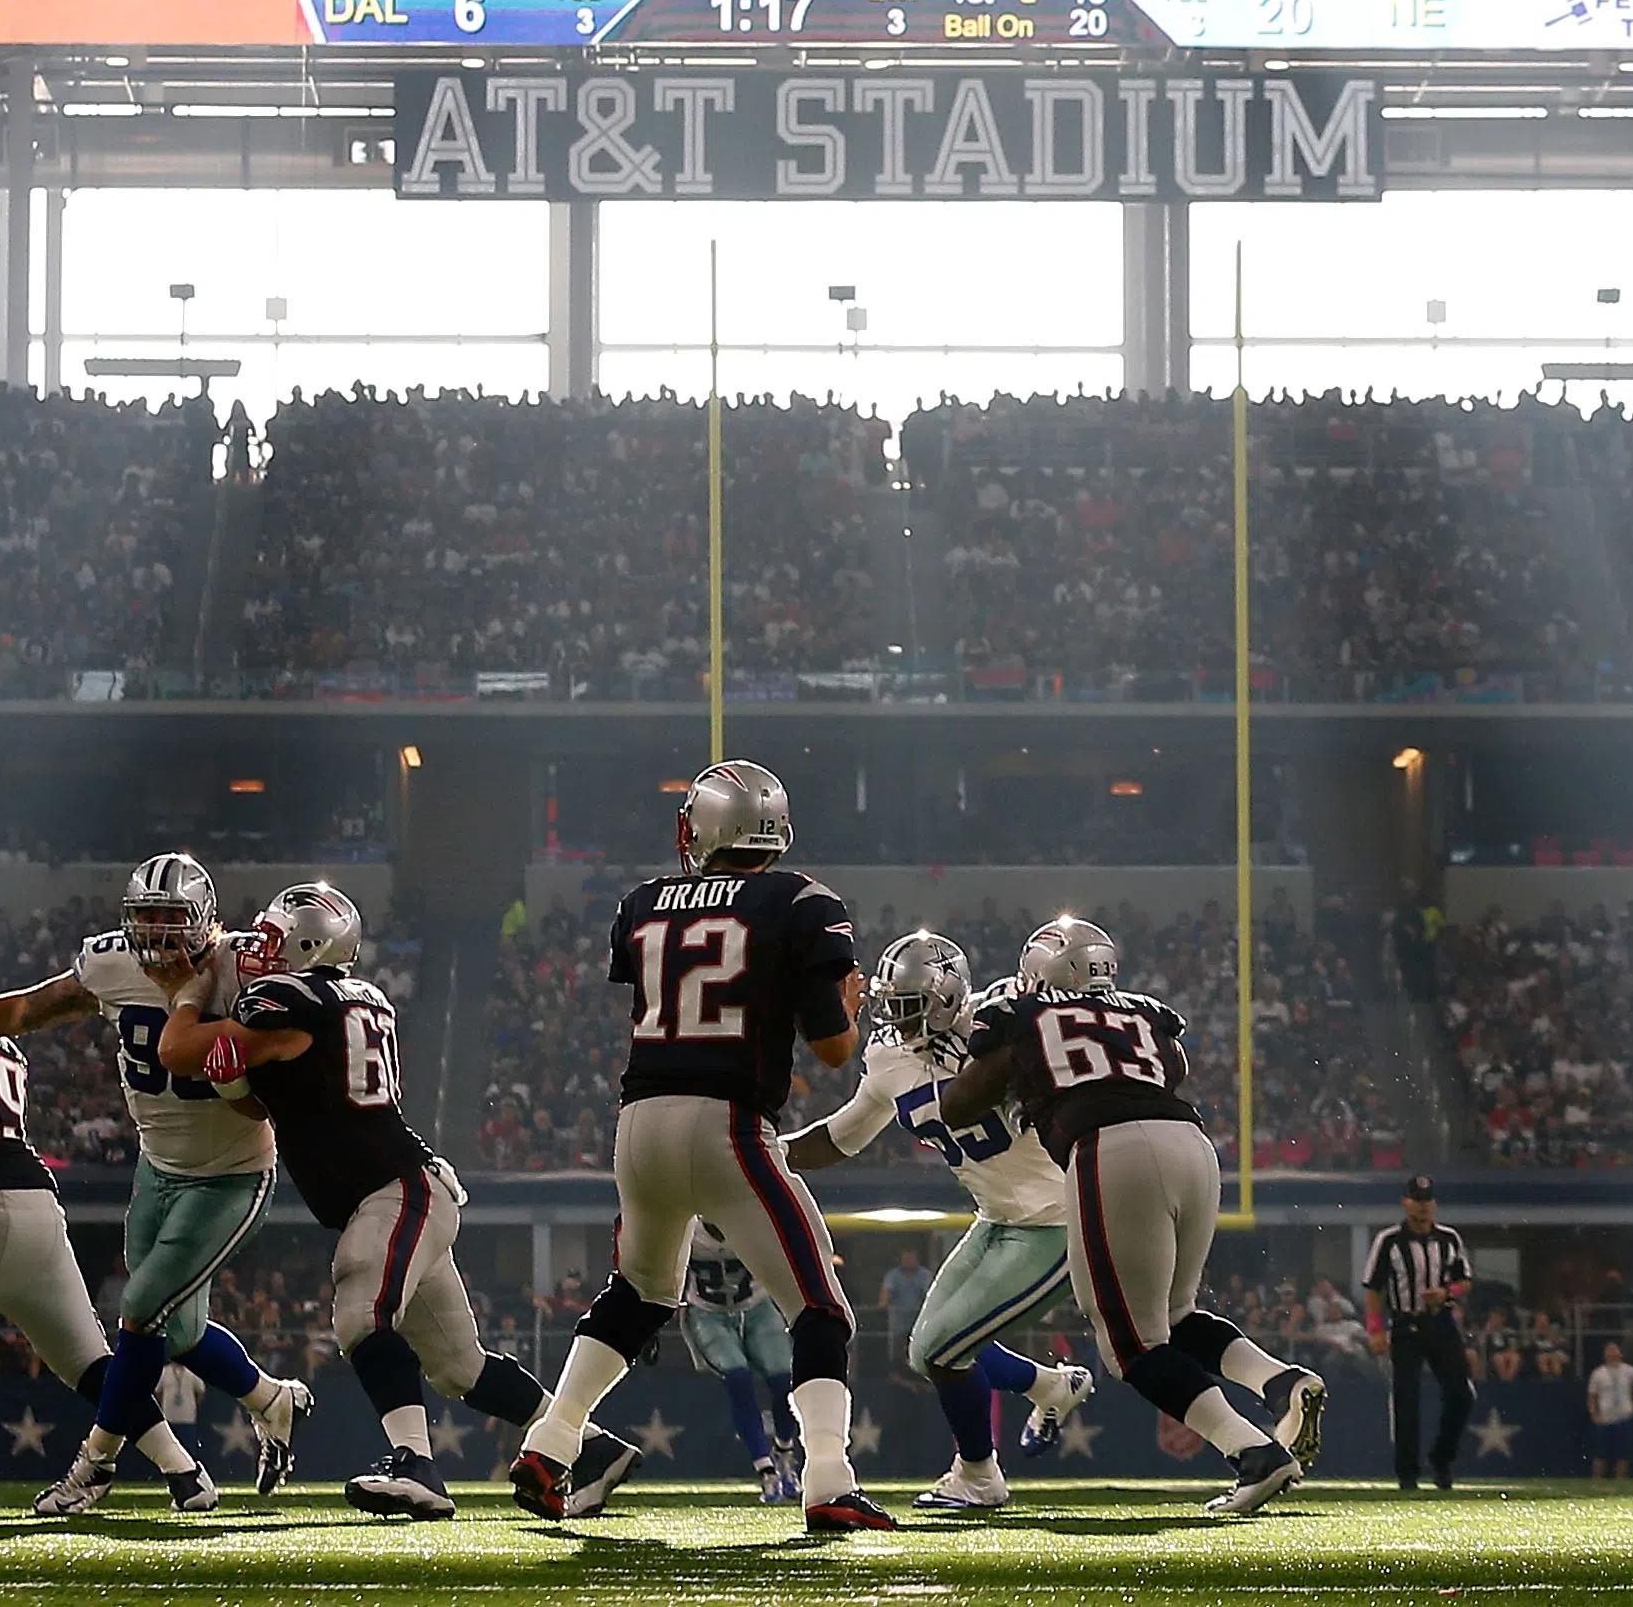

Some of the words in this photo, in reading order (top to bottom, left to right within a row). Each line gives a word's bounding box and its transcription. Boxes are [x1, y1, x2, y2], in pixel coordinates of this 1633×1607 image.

[576, 8, 596, 35] 3
[886, 9, 907, 36] 3
[943, 13, 991, 39] Ball
[996, 15, 1035, 39] On
[1069, 9, 1108, 37] 20
[402, 77, 734, 194] AT&T
[776, 77, 1375, 194] STADIUM
[759, 819, 775, 834] 12
[653, 879, 745, 912] BRADY
[631, 916, 750, 1042] 12
[1035, 1006, 1166, 1090] 63
